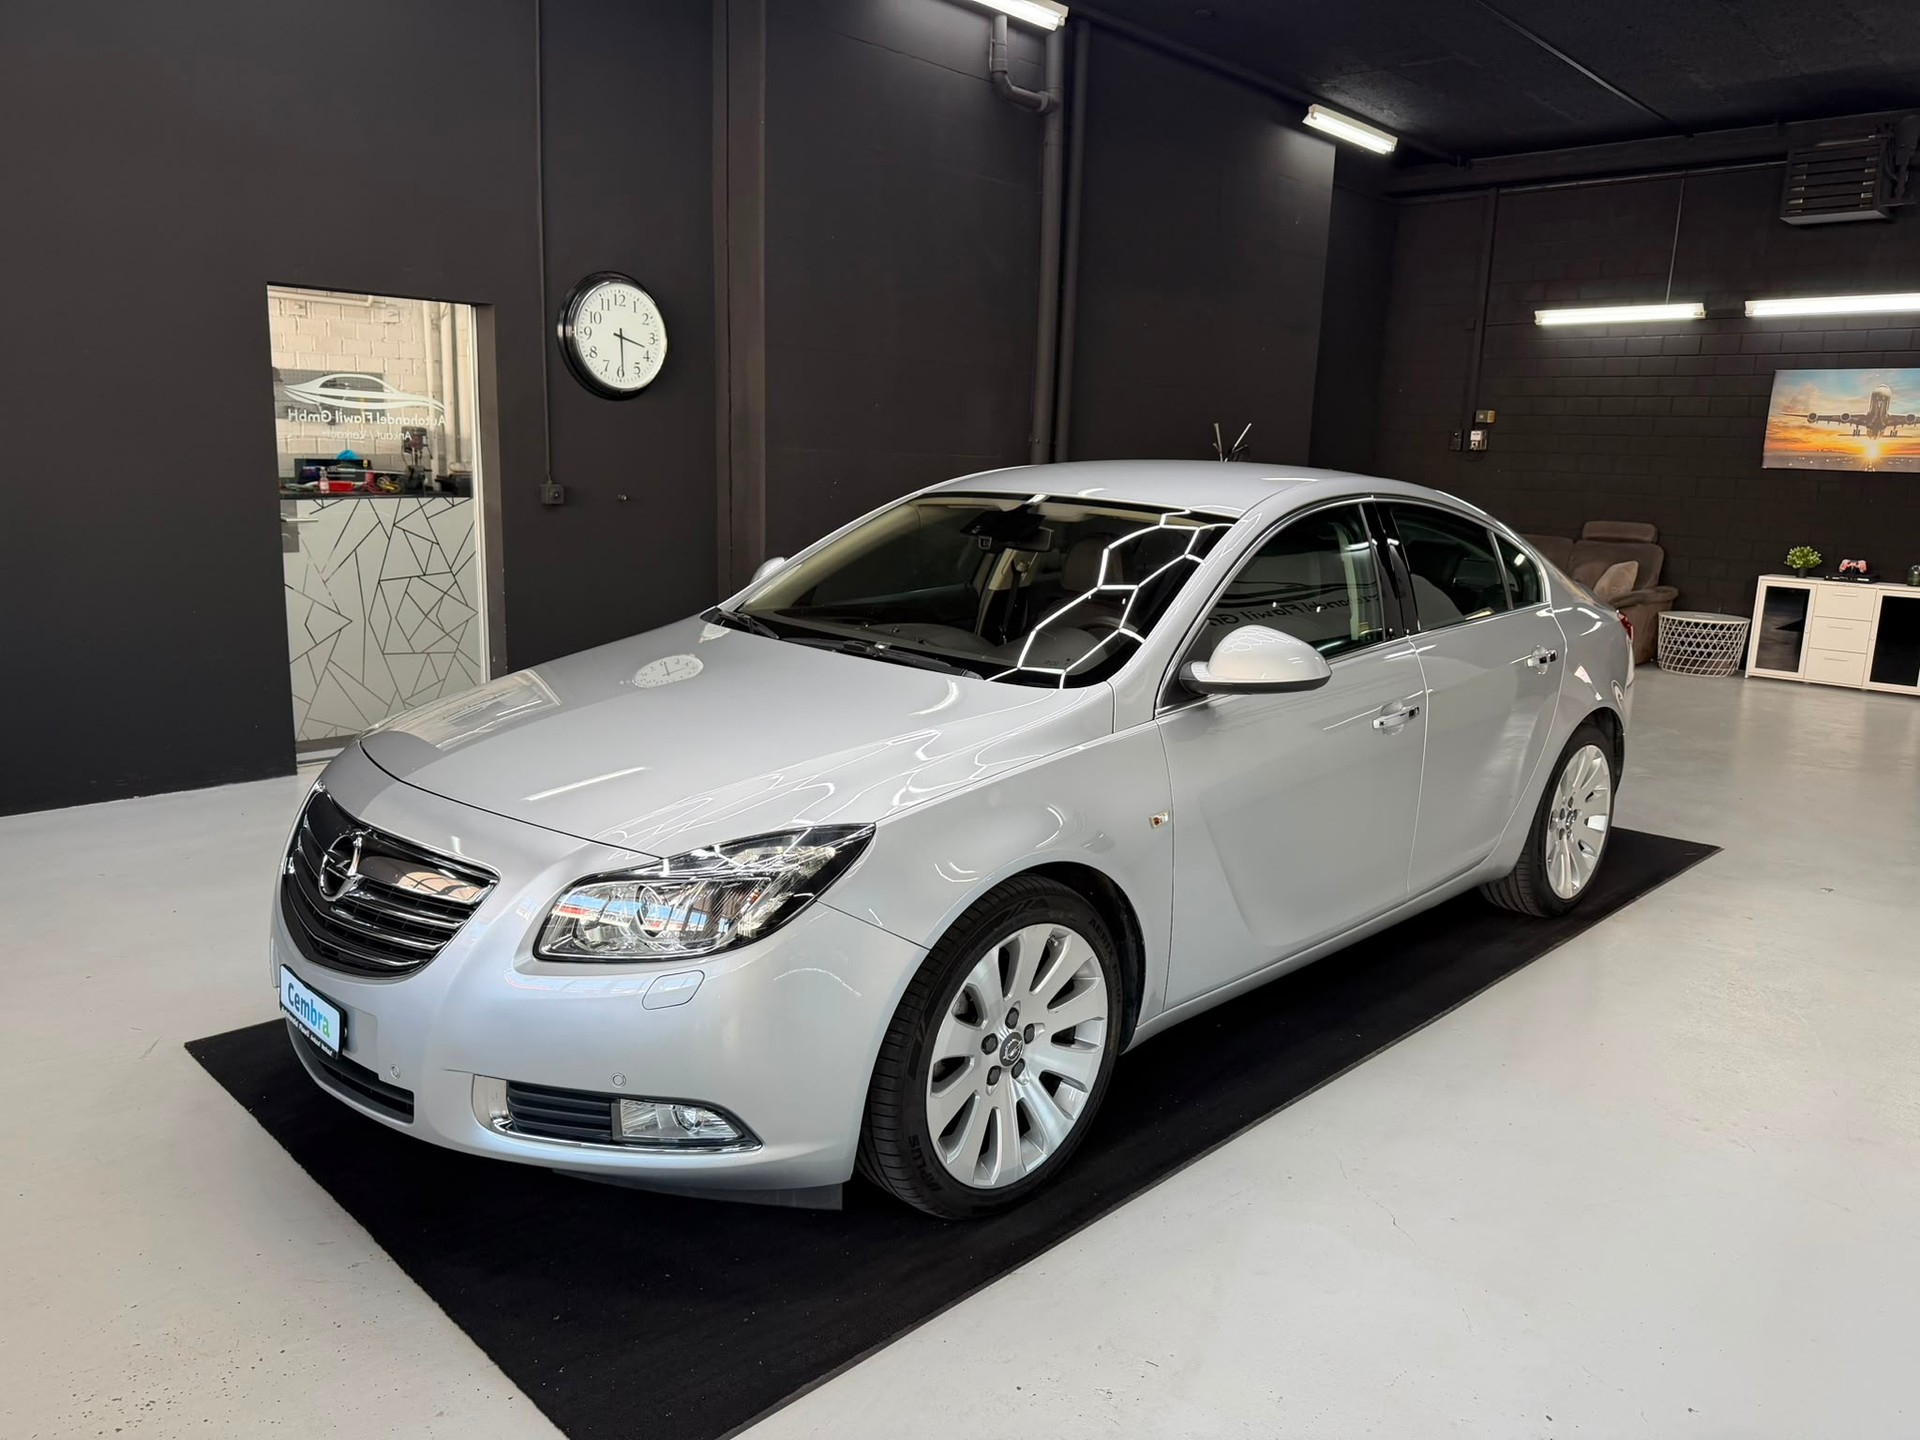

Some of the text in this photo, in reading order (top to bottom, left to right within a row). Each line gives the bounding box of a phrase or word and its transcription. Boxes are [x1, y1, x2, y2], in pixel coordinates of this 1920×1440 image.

[600, 298, 610, 311] 11
[614, 293, 626, 307] 12
[589, 311, 602, 324] 10
[642, 313, 649, 326] 2
[584, 326, 592, 340] 9
[649, 332, 656, 345] 3
[589, 346, 598, 358] 8
[643, 350, 651, 362] 4
[602, 360, 611, 372] 7
[616, 366, 625, 378] 6
[633, 362, 641, 374] 5
[287, 982, 330, 1038] Cembra
